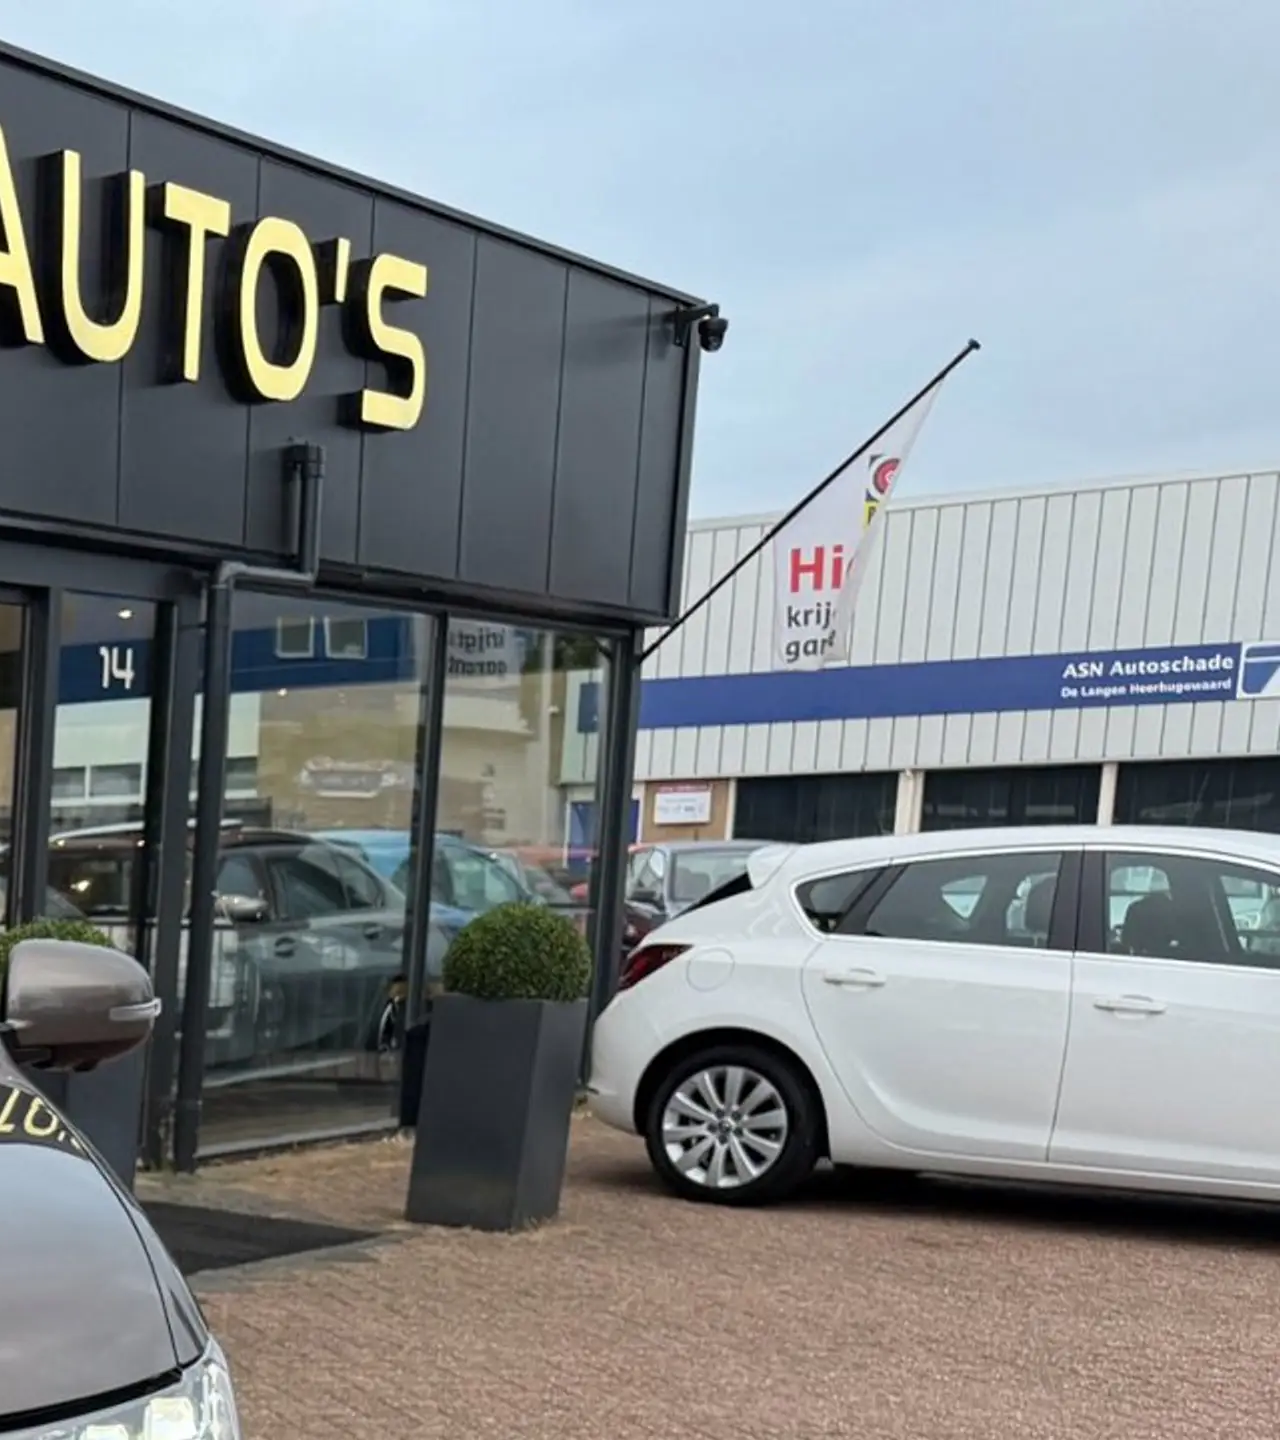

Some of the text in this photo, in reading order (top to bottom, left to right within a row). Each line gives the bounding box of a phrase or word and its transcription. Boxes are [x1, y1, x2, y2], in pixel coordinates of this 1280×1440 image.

[790, 545, 855, 593] Hi
[786, 602, 837, 630] krij
[99, 646, 135, 690] 14
[1062, 653, 1234, 679] ASN Autoschade
[1060, 686, 1078, 698] De
[1129, 678, 1232, 695] Heerhugowaard
